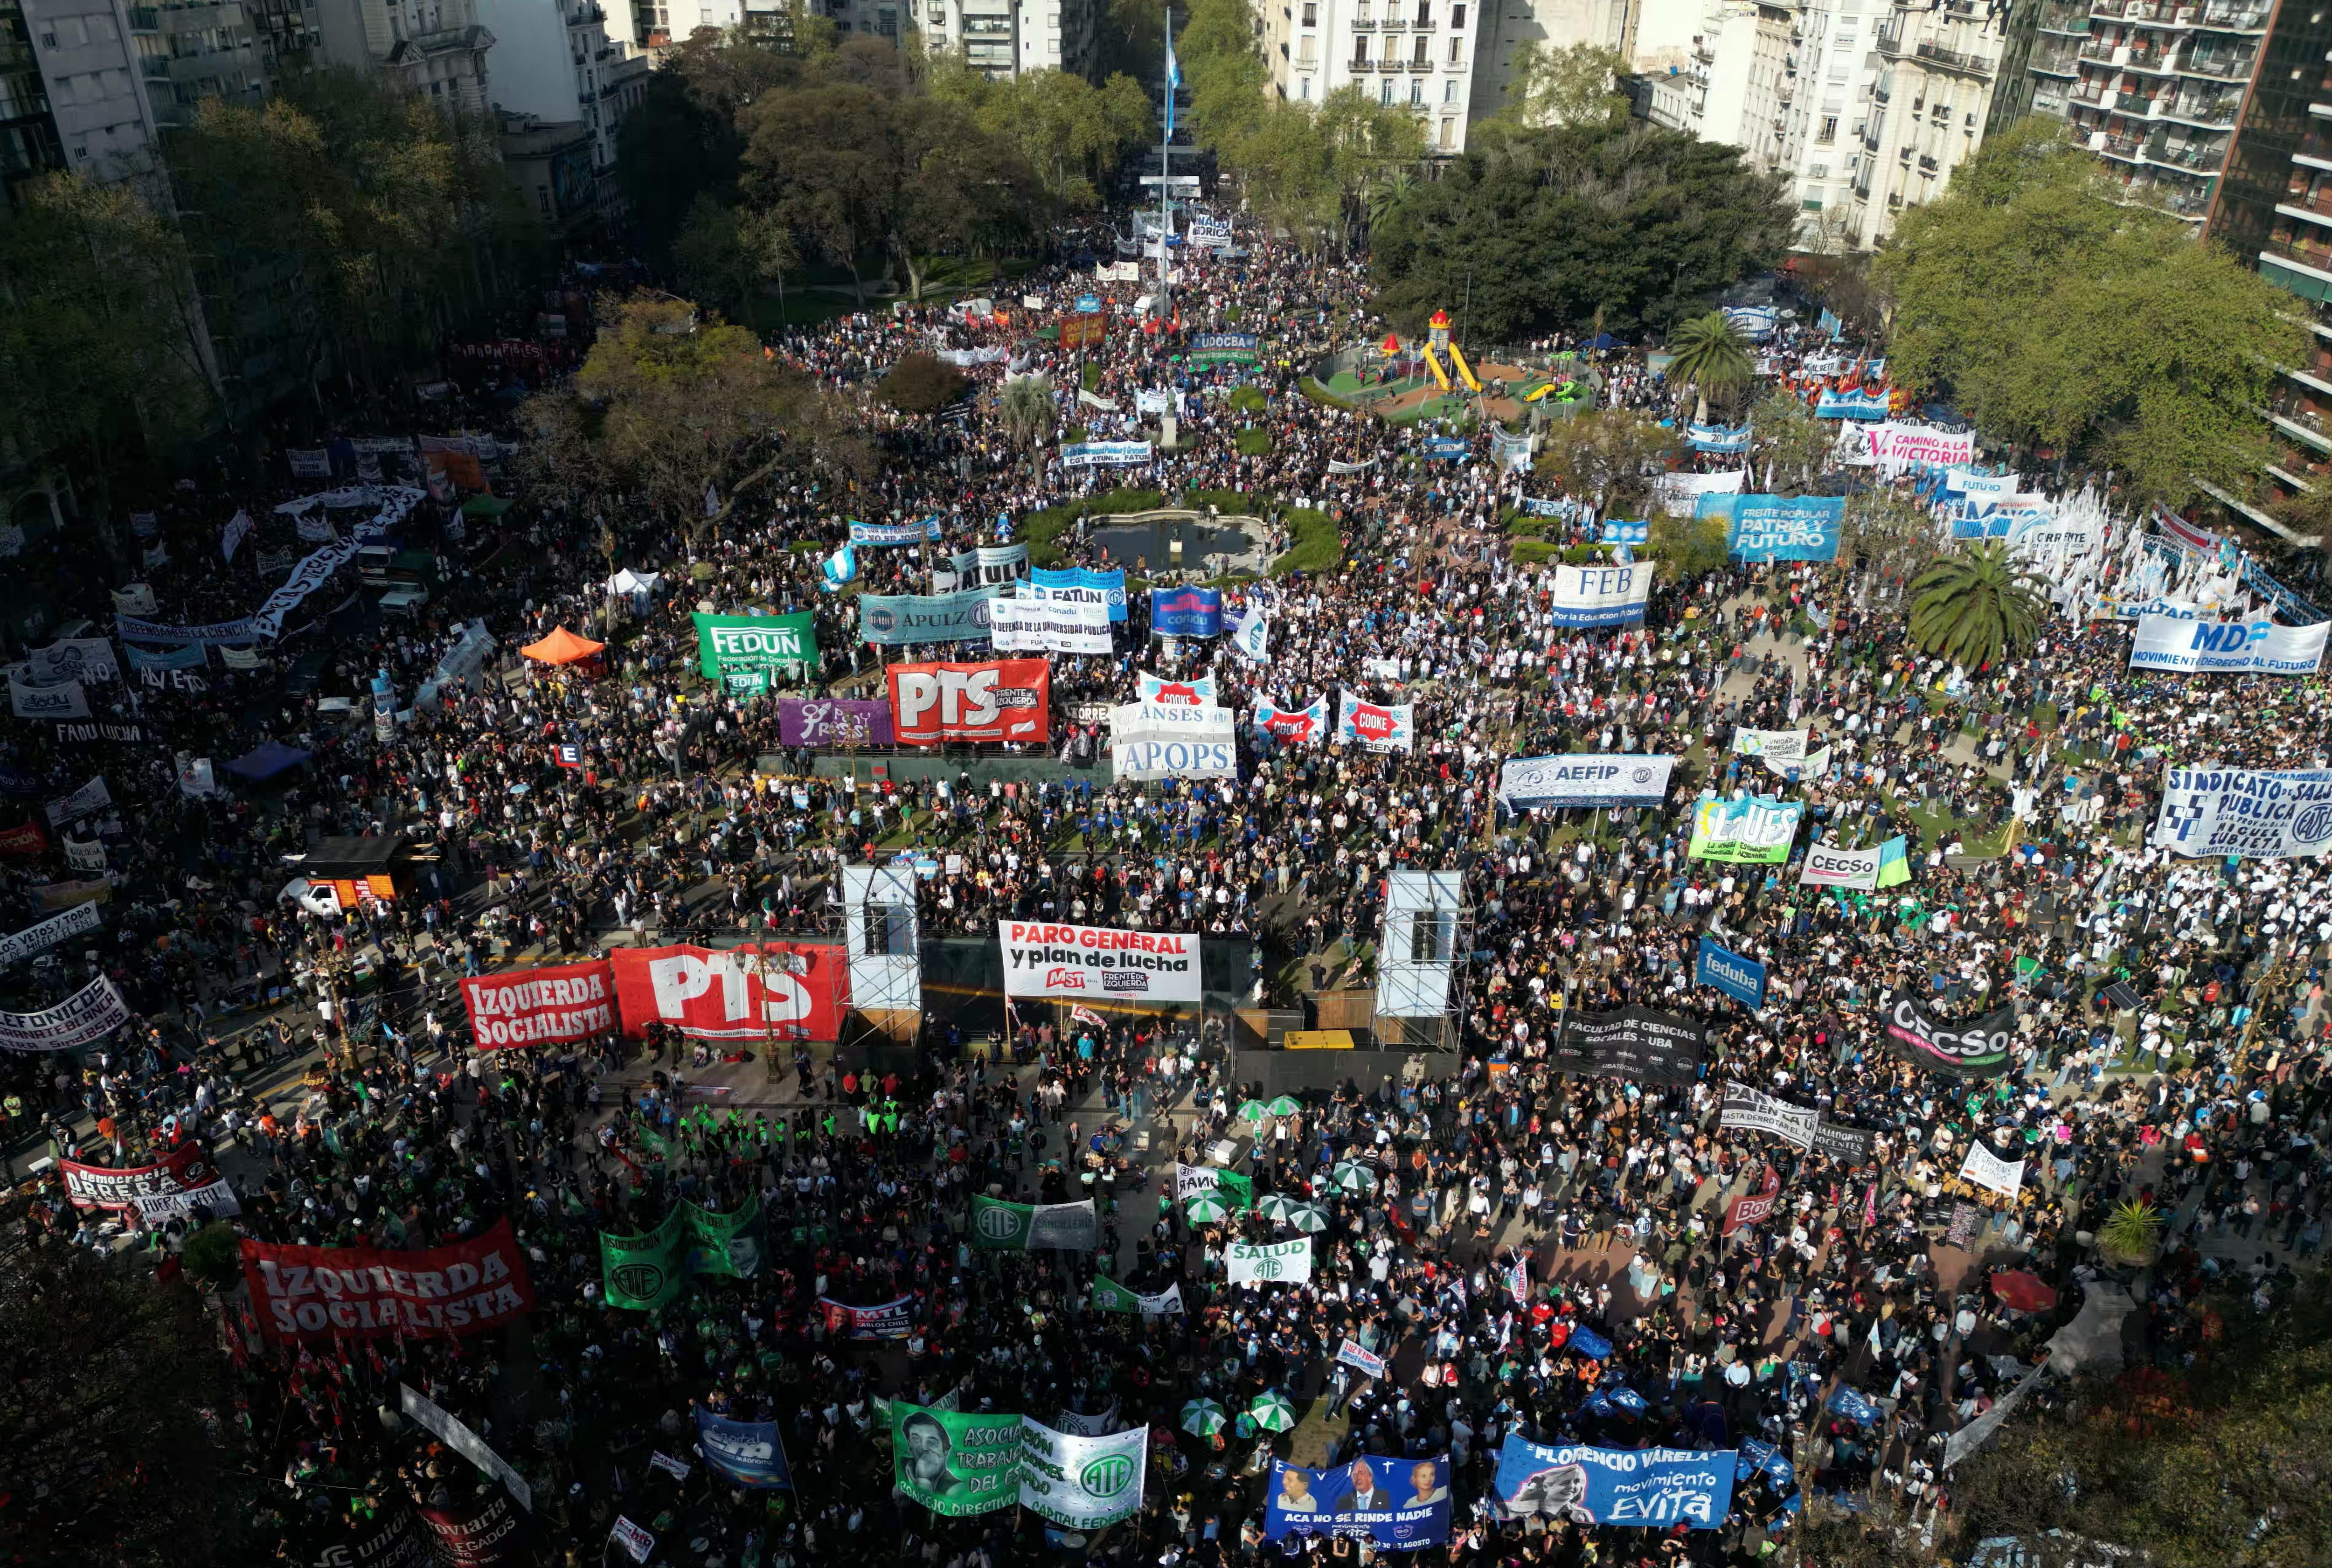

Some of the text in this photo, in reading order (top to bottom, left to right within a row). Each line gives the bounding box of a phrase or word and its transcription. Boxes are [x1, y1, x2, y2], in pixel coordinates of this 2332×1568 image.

[1201, 336, 1246, 348] UDOCBA
[1820, 362, 1834, 371] VETO
[1710, 434, 1722, 443] 20
[1895, 434, 1940, 448] CAMINO
[1953, 441, 1968, 450] LA
[1892, 444, 1970, 464] VICTORIA
[1963, 480, 2001, 492] FUTURO
[1743, 508, 1831, 518] FRENTE POPULAR
[1740, 518, 1825, 533] PATRIA Y
[1735, 533, 1825, 548] FUTURO
[962, 561, 1027, 591] ATULP
[1579, 568, 1633, 595] FEB
[1052, 589, 1102, 603] FATUN
[902, 611, 968, 628] APULZ
[1553, 611, 1577, 621] Por la
[2117, 602, 2194, 619] LEALTAD
[209, 622, 252, 638] CIENCIA
[991, 620, 1111, 636] EN DEFENSA DE LA UNIVERSIDAD PÚBLICA
[710, 626, 801, 654] FEDUN
[2199, 657, 2317, 670] DERECHO AL FUTURO
[82, 662, 110, 686] NO
[726, 672, 763, 687] FEDUN
[897, 668, 1000, 727] PTS
[995, 689, 1027, 698] FRENTE
[996, 697, 1037, 706] IZQUIERDA
[1164, 693, 1191, 705] COOKE
[1139, 706, 1203, 722] ANSES
[1359, 712, 1388, 731] COOKE
[56, 722, 141, 742] FADU LUCHA
[1274, 721, 1304, 735] COOKE
[1764, 742, 1801, 751] EGRESADOS
[1769, 736, 1794, 745] UNIDAD
[1122, 742, 1229, 771] APOPS
[1770, 748, 1801, 756] SOCIALES
[1555, 765, 1620, 780] AEFIP
[2168, 770, 2283, 801] SINDICATO
[2217, 794, 2296, 820] PUBLICA
[2217, 823, 2279, 837] MIGUEL
[2208, 833, 2282, 849] ZUBIETA
[1811, 854, 1874, 873] CECSo
[18, 906, 91, 944] VETOS Y TODO
[1011, 924, 1187, 955] PARO GENERAL
[11, 952, 21, 962] DE
[27, 937, 52, 954] MILEI
[1010, 946, 1188, 972] y plan de lucha
[1049, 968, 1084, 986] MST
[1706, 951, 1758, 992] feduba
[649, 951, 812, 1022] PTS
[1104, 979, 1148, 988] IZQUIERDA
[468, 973, 604, 1018] IZQUIERDA
[66, 992, 116, 1029] BLANCA
[475, 1003, 612, 1045] SOCIALISTA
[1569, 1019, 1697, 1041] FACULTAD DE CIENCIAS
[1894, 999, 2009, 1056] CECSo
[1585, 1031, 1673, 1049] SOCIALES UBA
[1617, 1050, 1637, 1059] feduba
[1721, 1111, 1800, 1136] HASTA DERROTAR EL
[1758, 1105, 1800, 1126] EN LA
[79, 1165, 171, 1185] democracia
[65, 1170, 178, 1199] OBRERA
[143, 1196, 182, 1213] FUERA
[982, 1209, 1019, 1235] ATE
[1642, 1222, 1650, 1231] 10
[603, 1232, 661, 1252] ASOCIACION
[1233, 1242, 1306, 1260] SALUD
[259, 1249, 510, 1302] IZQUIERDA
[1256, 1261, 1281, 1279] ATE
[270, 1282, 525, 1333] SOCIALISTA
[855, 1305, 909, 1319] MTL
[965, 1423, 1054, 1458] ASOCIACIÓN
[955, 1448, 1065, 1482] TRABAJADORES
[970, 1465, 1052, 1496] DEL ESTADO
[1086, 1458, 1127, 1491] ATE
[1614, 1471, 1717, 1494] movimiento
[900, 1480, 1017, 1517] CONSEJO DIRECTIVO
[1031, 1501, 1138, 1530] CAPITAL FEDERAL
[1284, 1506, 1433, 1523] ACA NO SE RINDE NADIE
[1402, 1538, 1431, 1548] AGOSTO
